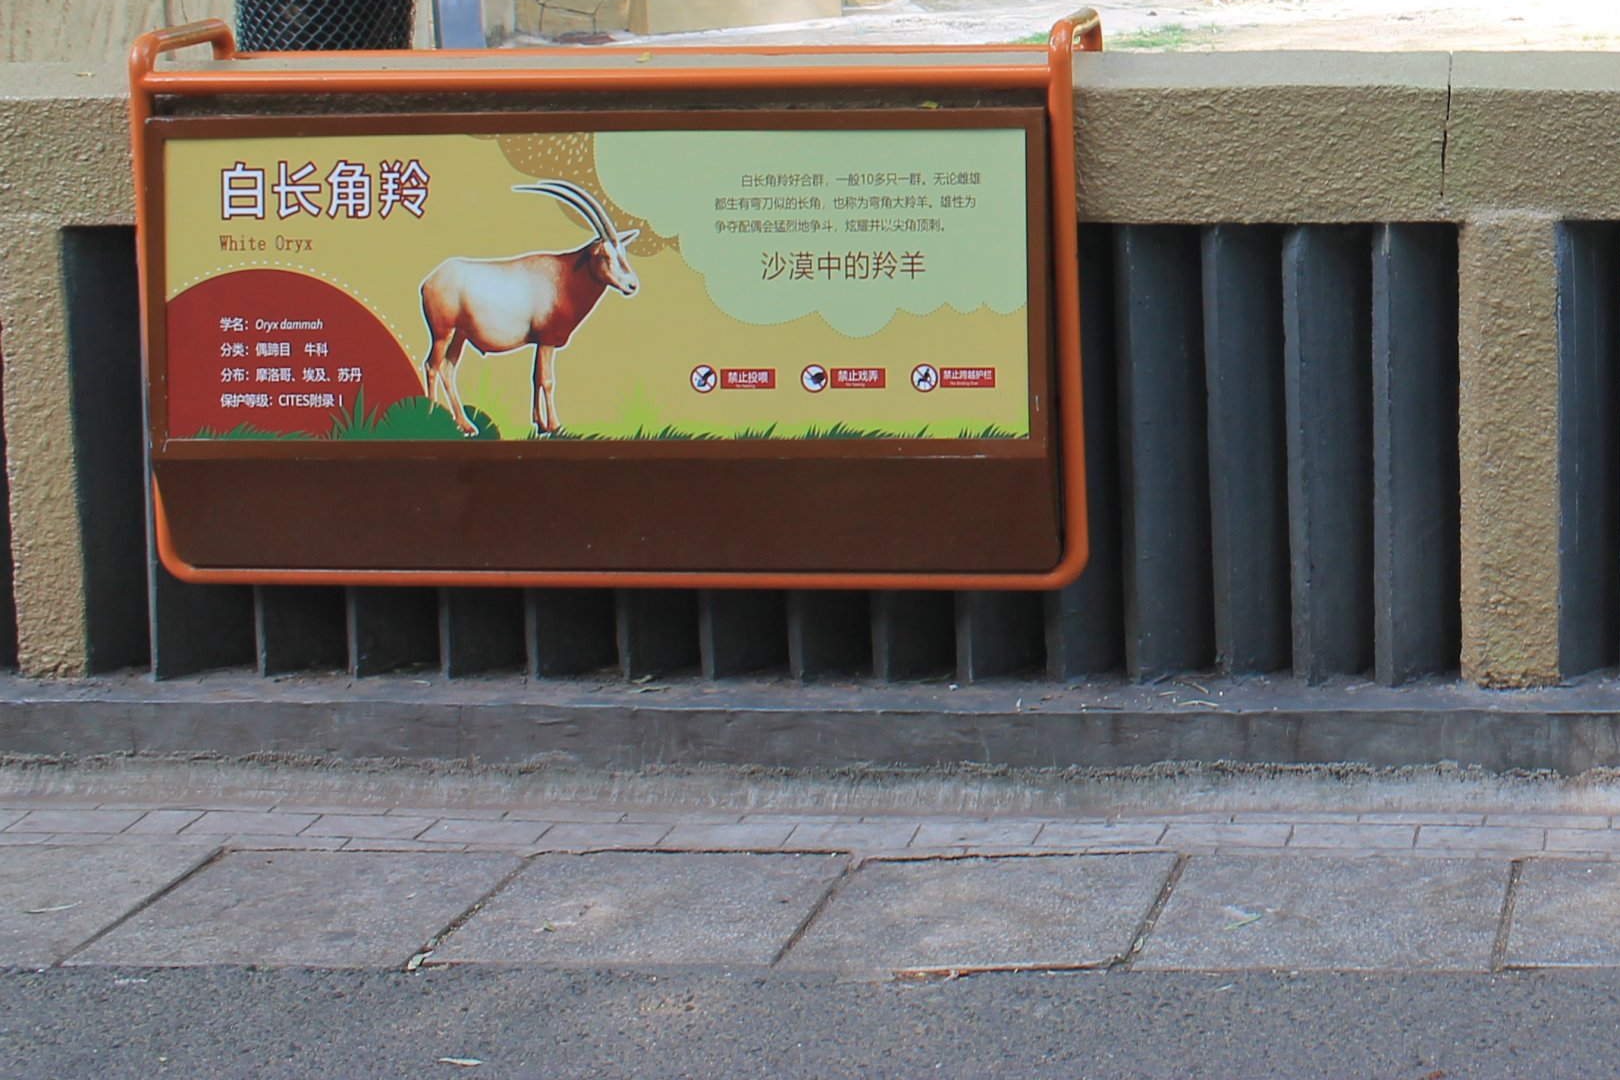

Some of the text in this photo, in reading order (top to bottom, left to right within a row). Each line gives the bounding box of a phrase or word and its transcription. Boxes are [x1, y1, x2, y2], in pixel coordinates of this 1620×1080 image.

[220, 159, 430, 220] 白长角羚
[219, 234, 313, 253] White Oryx
[761, 250, 926, 281] 沙漠中的羚羊
[280, 319, 324, 330] dammah
